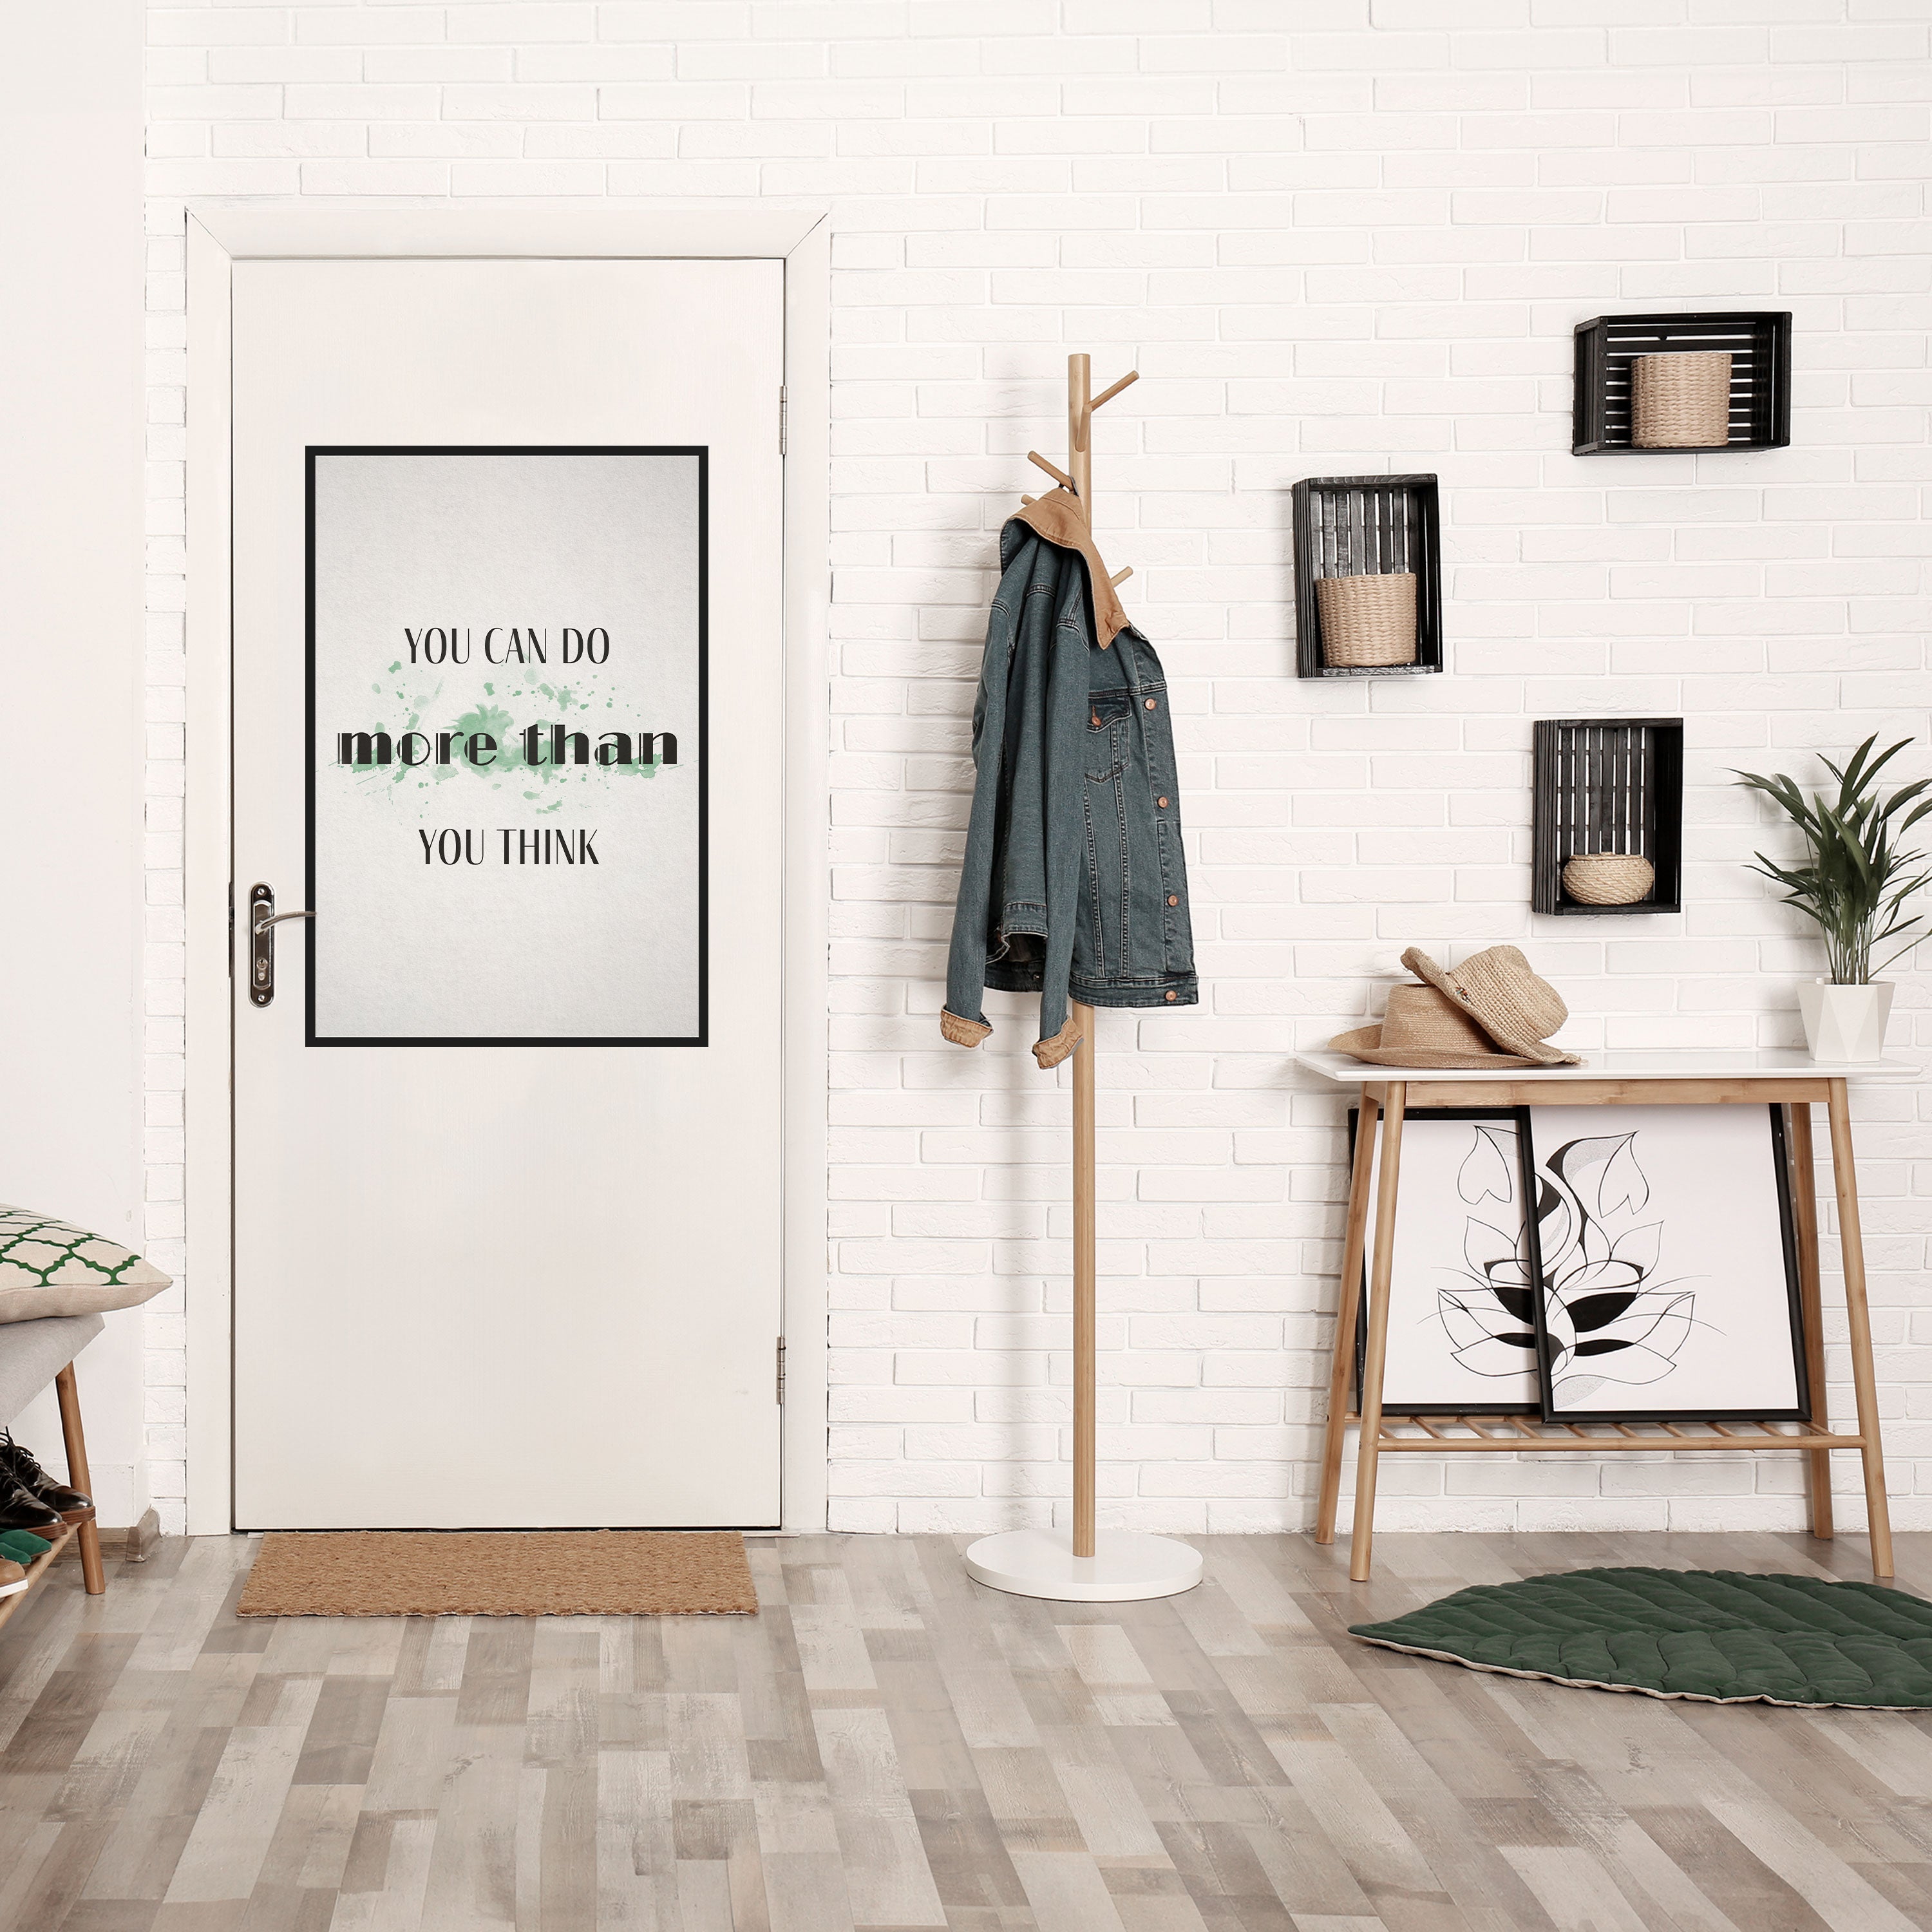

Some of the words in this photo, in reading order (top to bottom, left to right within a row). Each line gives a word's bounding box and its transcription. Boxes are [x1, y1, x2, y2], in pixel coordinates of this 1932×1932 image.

[404, 627, 470, 665] YOU
[484, 627, 547, 665] CAN
[562, 627, 611, 665] DO
[337, 731, 498, 766] more
[519, 723, 677, 766] than
[419, 828, 484, 866] YOU
[496, 828, 600, 866] THINK
